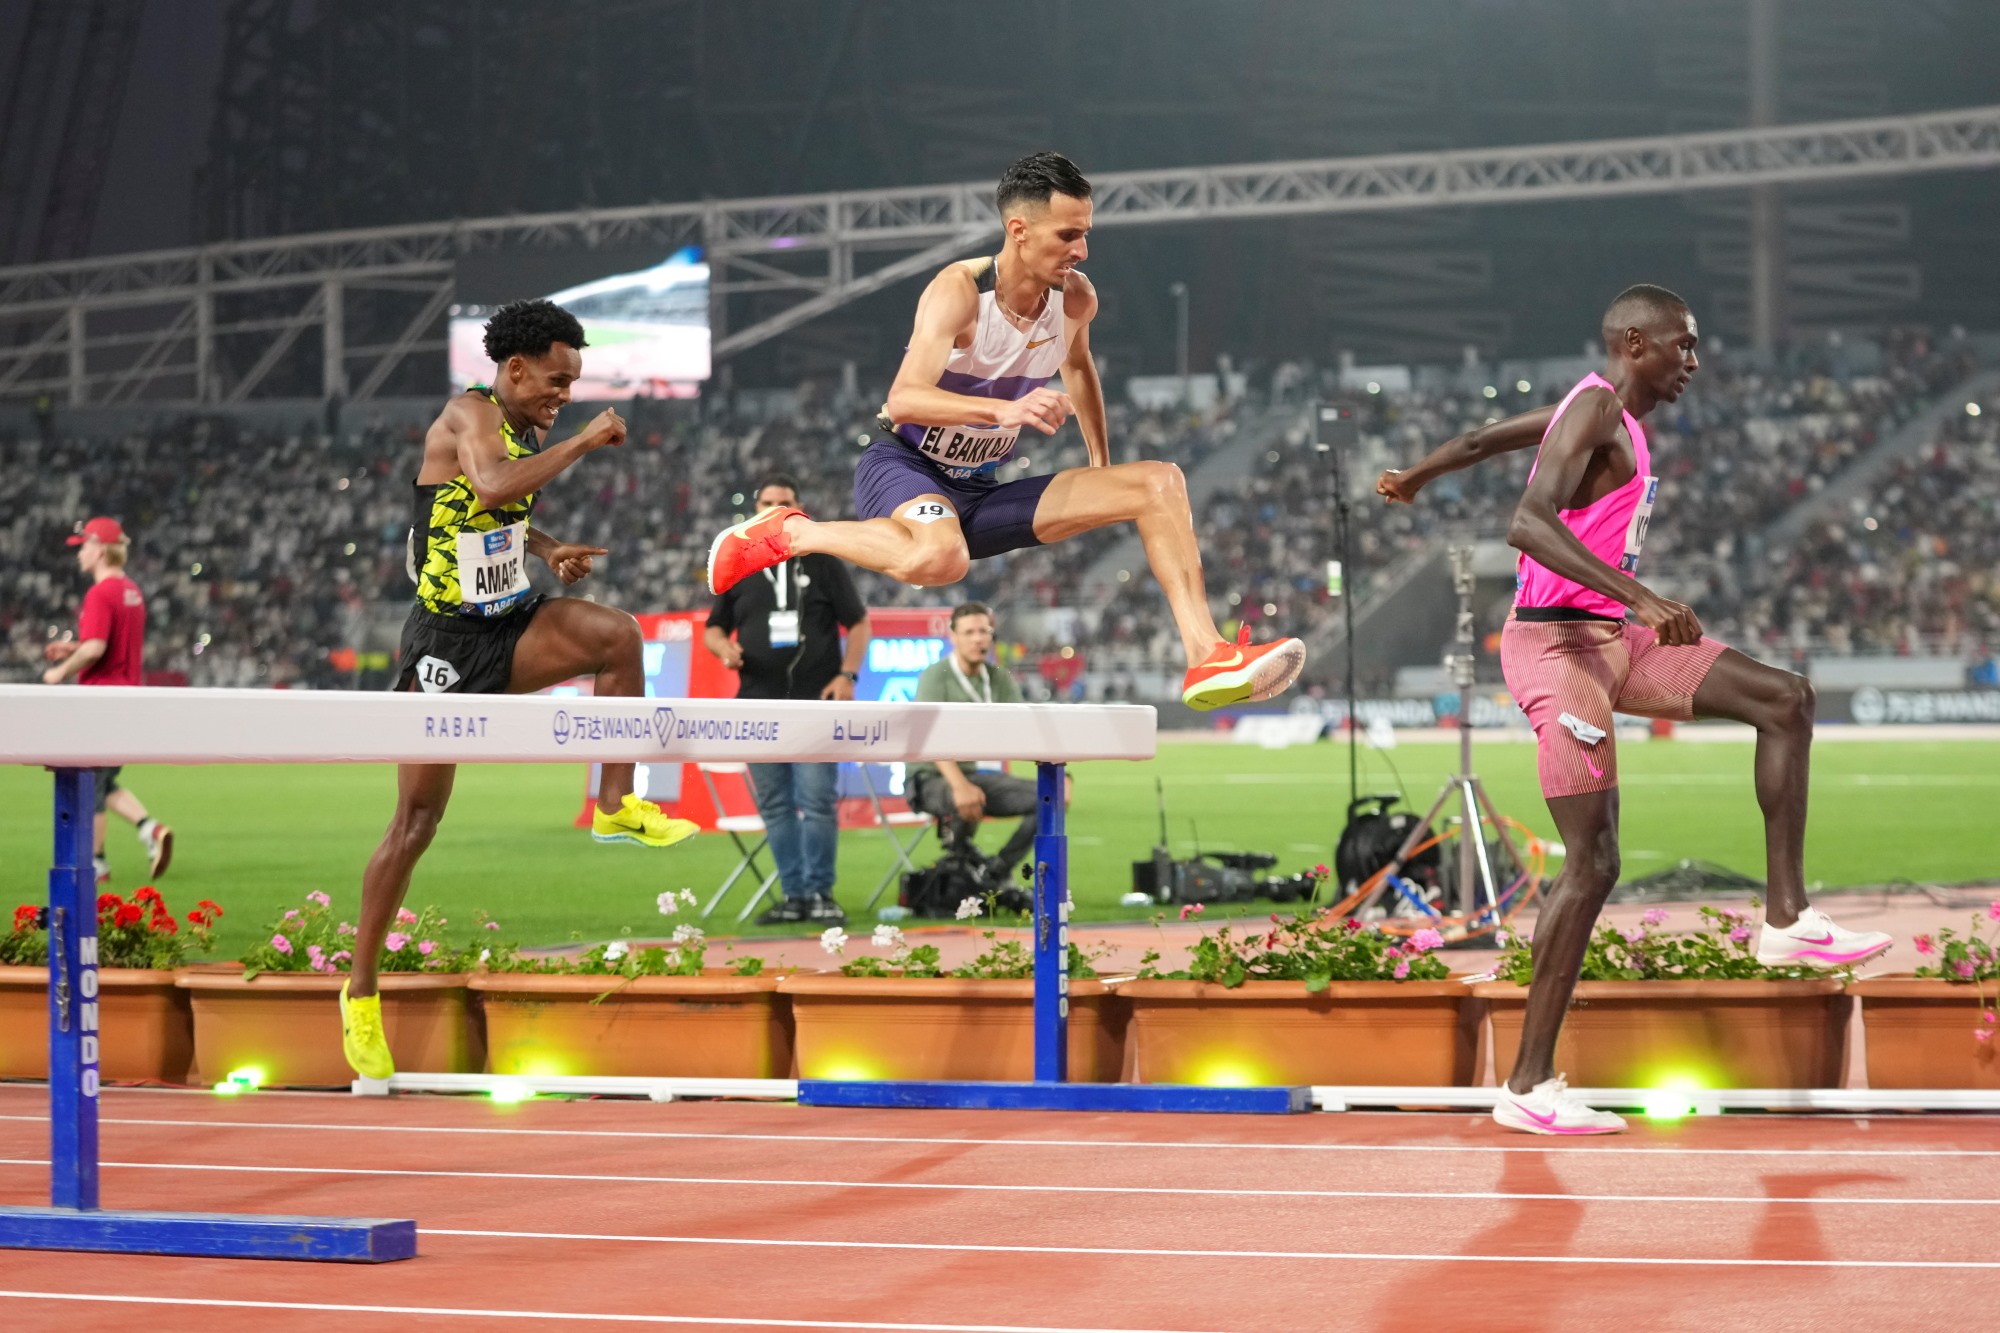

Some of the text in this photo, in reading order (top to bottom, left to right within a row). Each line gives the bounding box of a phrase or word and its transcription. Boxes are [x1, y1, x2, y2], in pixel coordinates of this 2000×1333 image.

[921, 426, 946, 455] EL
[917, 505, 944, 516] 19
[423, 663, 449, 687] 16
[426, 717, 488, 737] RABAT
[603, 717, 652, 739] WANDA
[677, 719, 733, 740] DIAMOND
[735, 721, 779, 741] LEAGUE
[833, 719, 888, 746] الرباط
[1058, 902, 1069, 1018] MONDO
[79, 936, 99, 1097] MONDO
